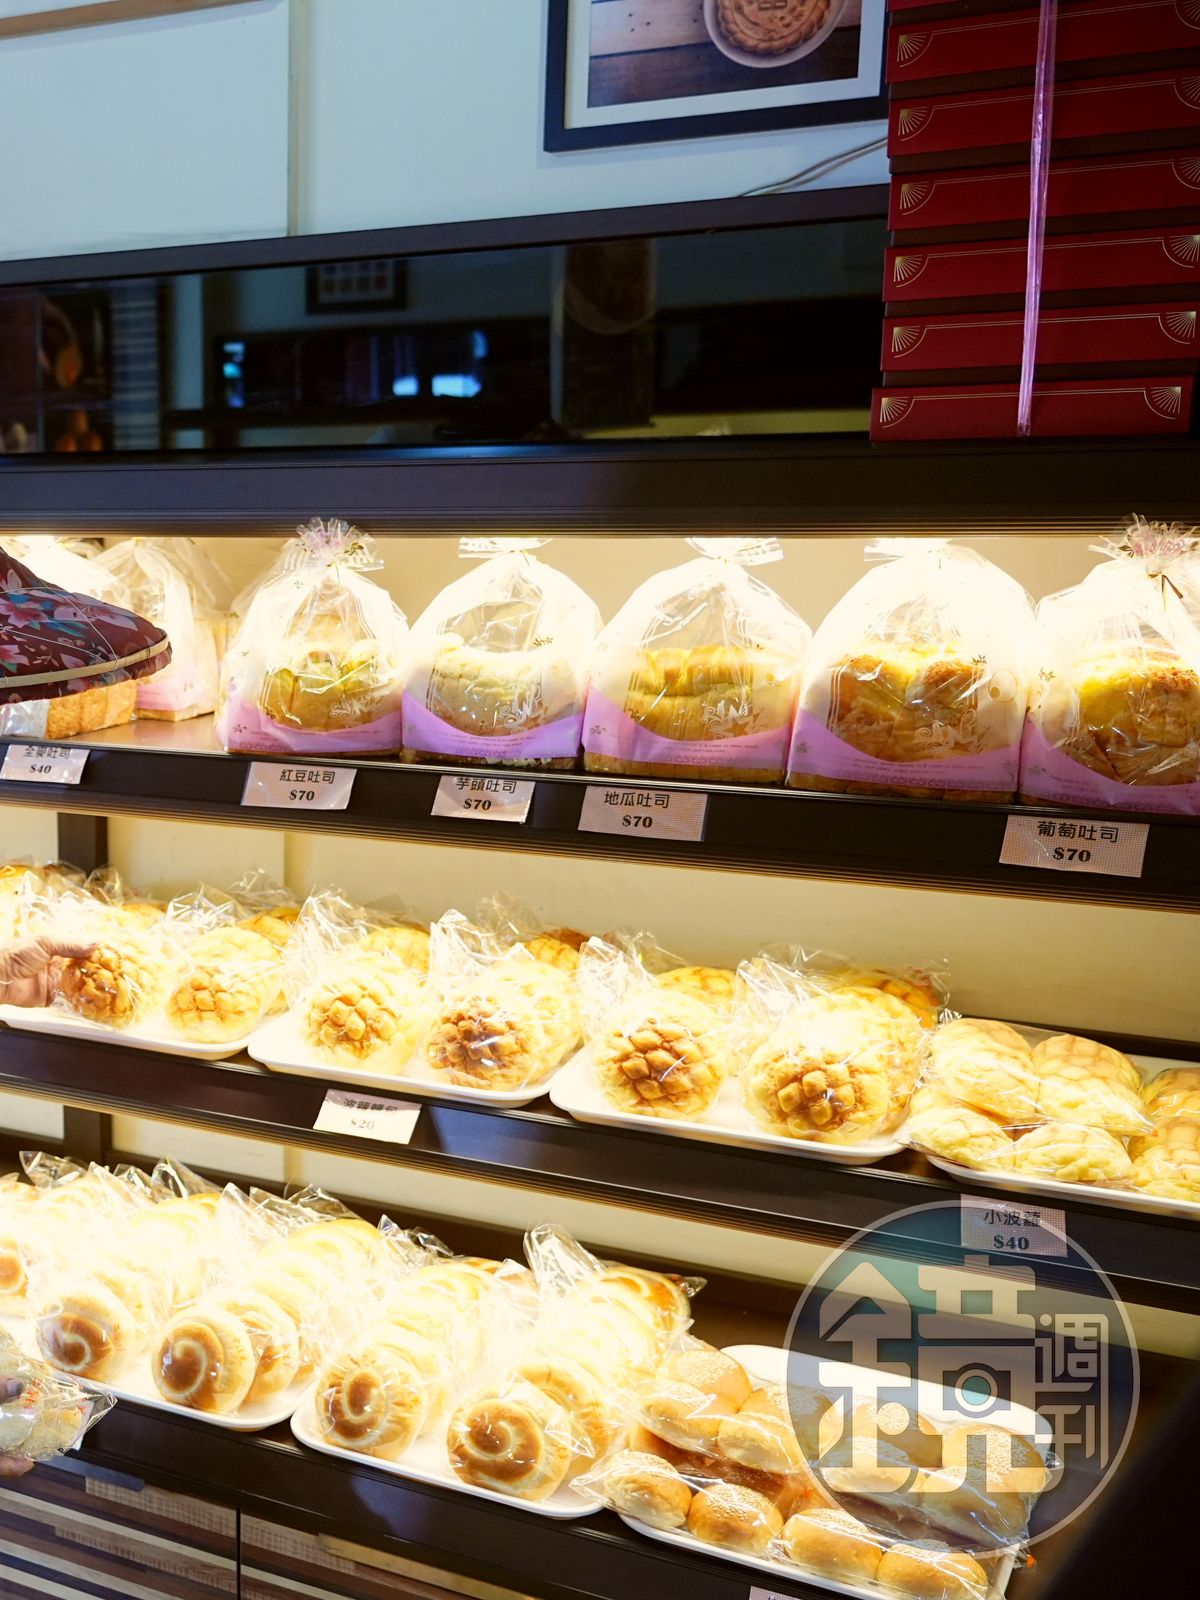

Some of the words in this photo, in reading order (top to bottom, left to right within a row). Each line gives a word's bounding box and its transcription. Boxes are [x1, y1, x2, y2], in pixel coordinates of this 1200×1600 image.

[22, 745, 71, 760] 全麥吐司
[29, 764, 52, 774] $40
[279, 767, 336, 785] 紅豆吐司
[455, 776, 517, 794] 芋頭吐司
[289, 789, 315, 802] $70
[463, 797, 492, 811] $70
[603, 789, 670, 809] 地瓜吐司
[622, 814, 653, 829] $70
[1037, 820, 1119, 843] 葡萄吐司
[1053, 846, 1091, 863] $70
[993, 1233, 1030, 1251] $40
